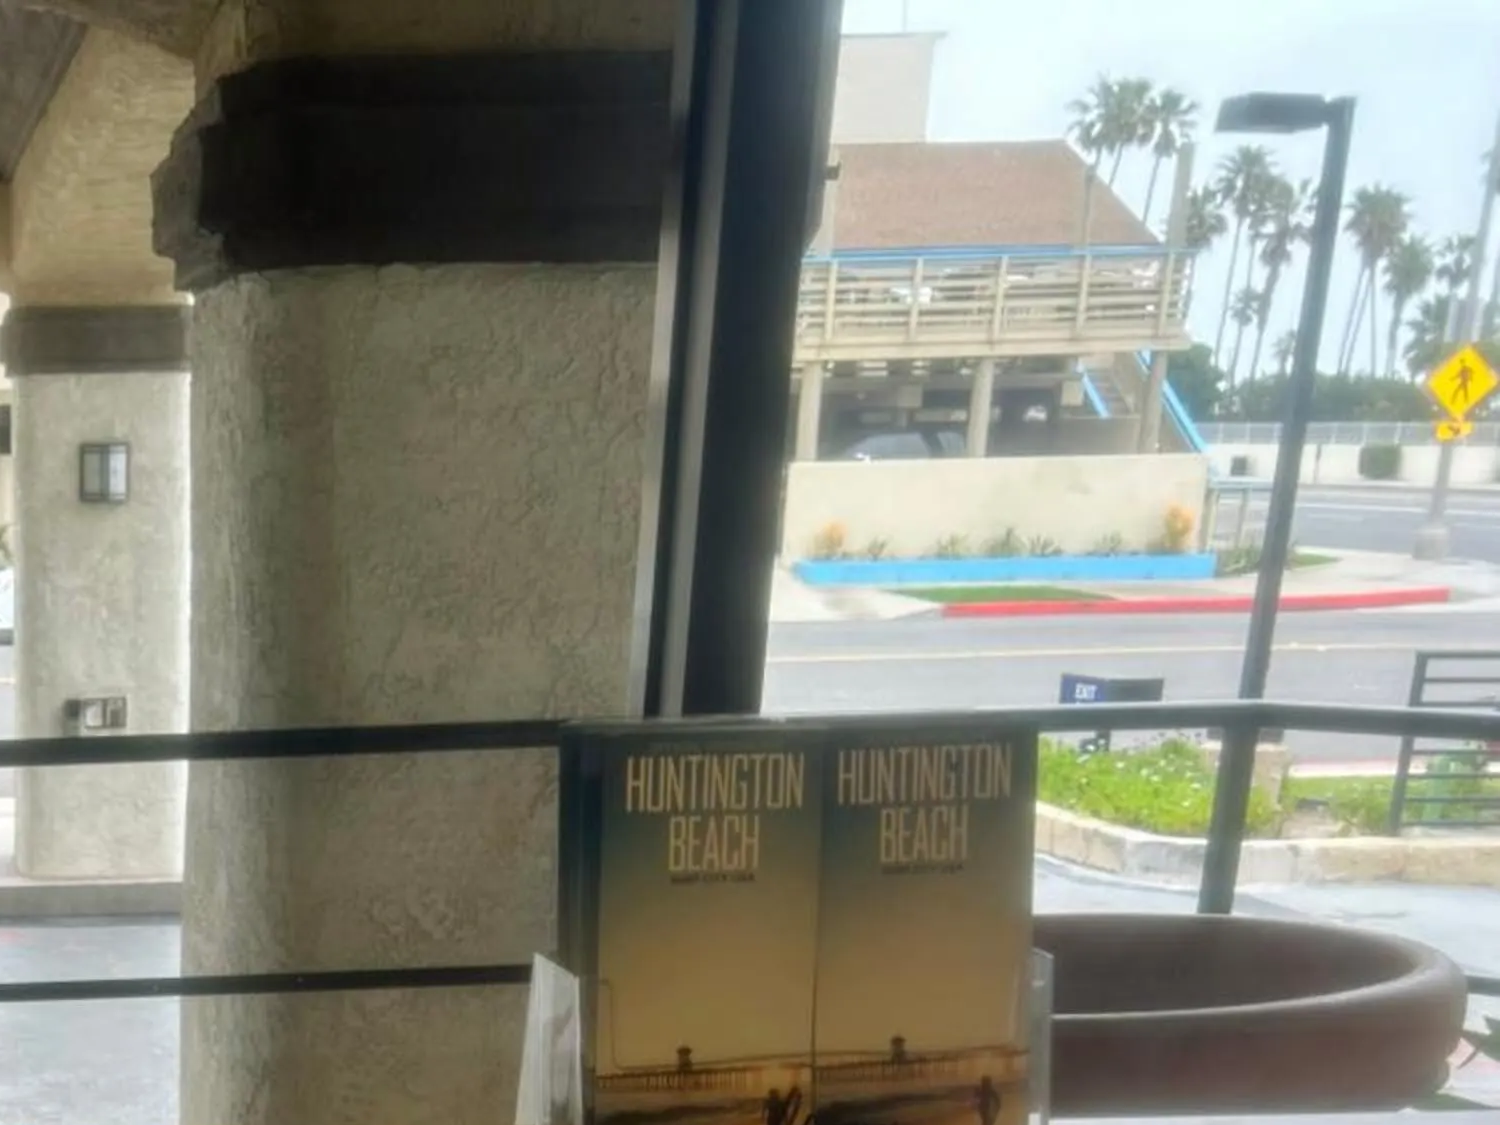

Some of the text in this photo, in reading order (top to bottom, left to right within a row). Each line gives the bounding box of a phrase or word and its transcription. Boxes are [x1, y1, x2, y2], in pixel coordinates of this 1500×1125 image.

[1074, 683, 1098, 700] EXIT
[626, 754, 804, 812] HUNTINGTON
[838, 745, 1012, 805] HUNTINGTON
[668, 815, 760, 872] BEACH
[880, 806, 968, 863] BEACH
